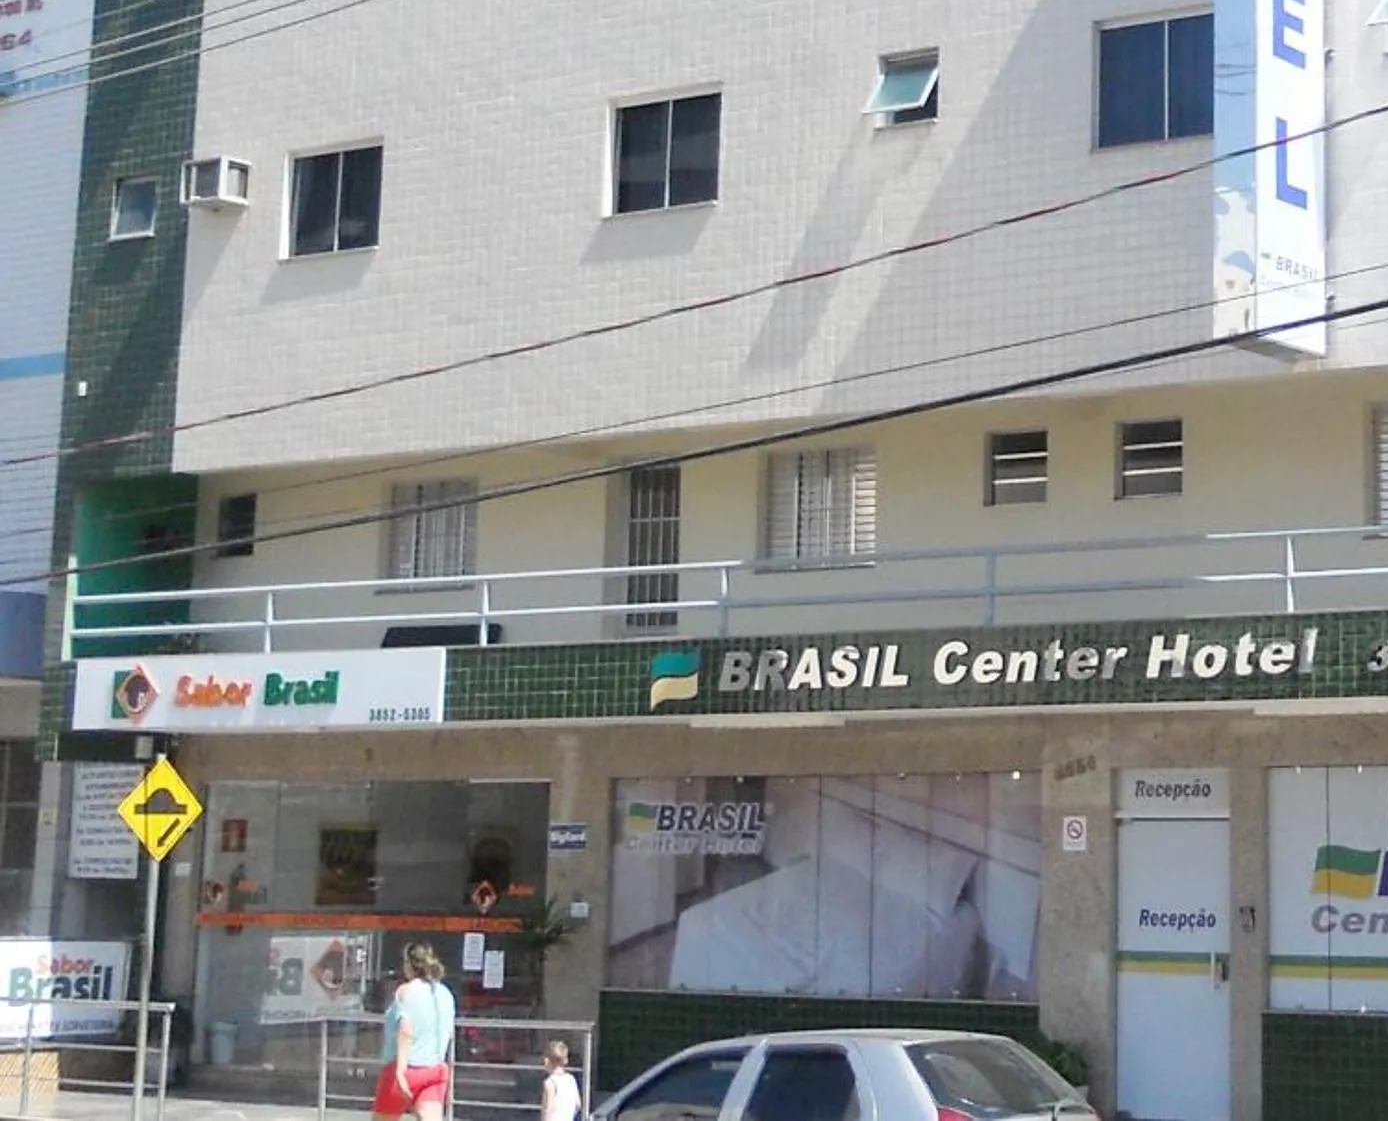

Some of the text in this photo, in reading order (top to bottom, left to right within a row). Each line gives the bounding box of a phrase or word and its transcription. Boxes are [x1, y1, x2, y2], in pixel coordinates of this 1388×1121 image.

[719, 645, 909, 692] BRASIL
[933, 640, 1126, 685] Center
[1145, 627, 1317, 679] Hotel
[174, 670, 340, 708] Sabor Brasil
[656, 804, 763, 831] BRASIL
[1138, 908, 1217, 932] Recepção
[37, 954, 94, 975] Sabor
[9, 965, 113, 1006] Brasil
